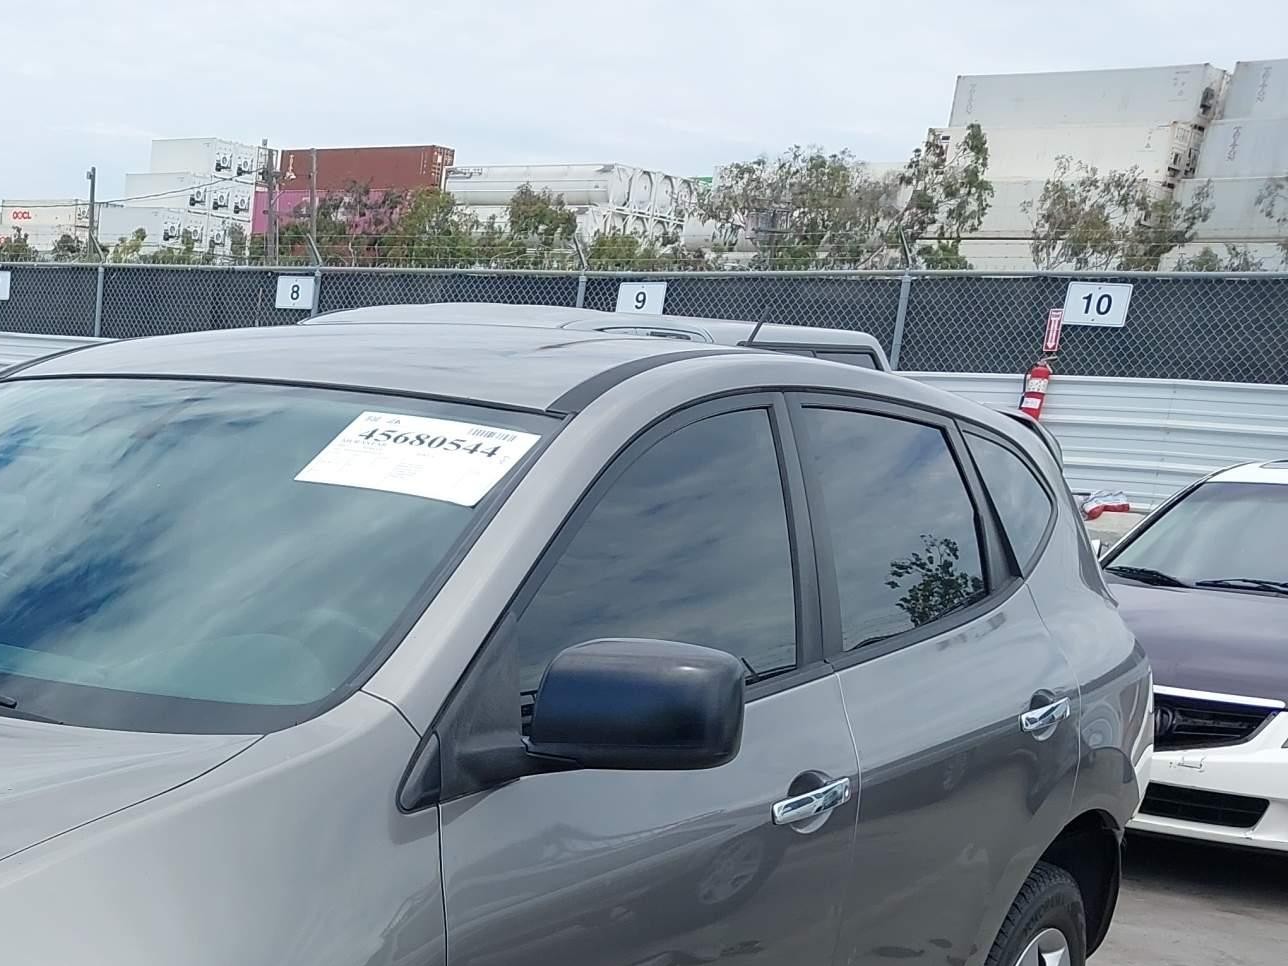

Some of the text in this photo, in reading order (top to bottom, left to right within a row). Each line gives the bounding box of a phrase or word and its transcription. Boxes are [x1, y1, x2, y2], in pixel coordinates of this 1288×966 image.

[291, 284, 300, 301] 8
[634, 291, 647, 310] 9
[1082, 293, 1113, 316] 10
[359, 427, 503, 459] 45680544
